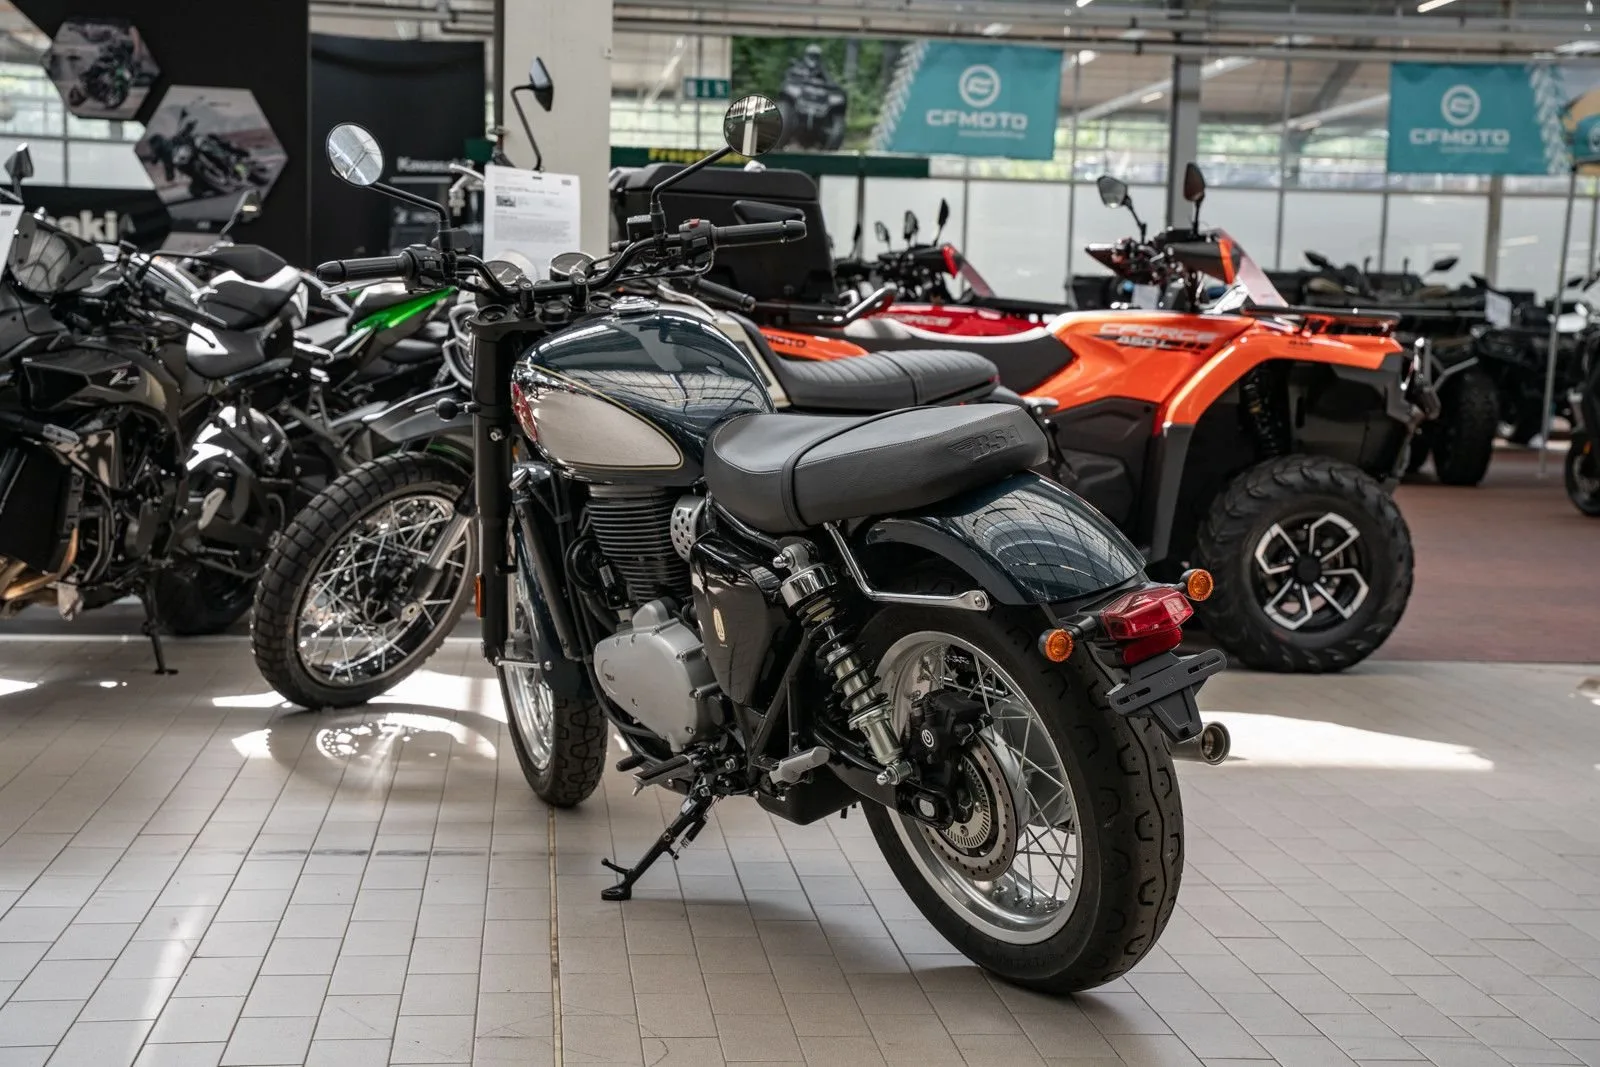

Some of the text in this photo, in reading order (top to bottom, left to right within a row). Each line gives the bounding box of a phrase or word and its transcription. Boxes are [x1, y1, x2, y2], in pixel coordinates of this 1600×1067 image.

[926, 109, 1028, 130] CFMOTO
[1409, 128, 1510, 146] CFMOTO
[1100, 323, 1218, 344] CFORCE
